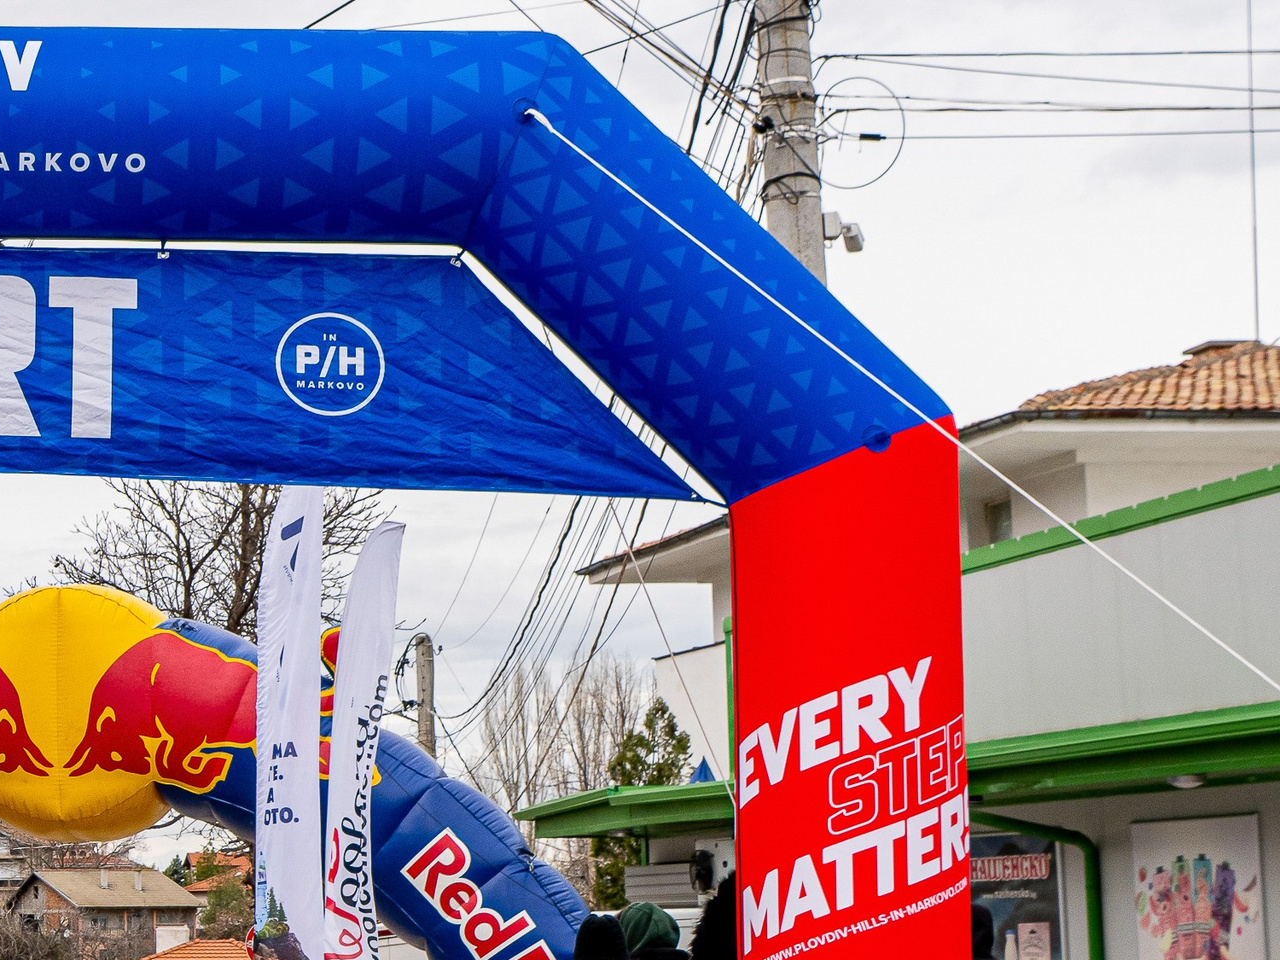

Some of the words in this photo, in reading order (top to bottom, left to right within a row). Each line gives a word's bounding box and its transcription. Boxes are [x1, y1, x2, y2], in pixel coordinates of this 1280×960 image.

[322, 333, 337, 342] IN
[296, 344, 365, 378] P/H
[296, 380, 365, 391] MARKOVO
[739, 656, 933, 810] EVERY
[827, 713, 966, 836] STEP
